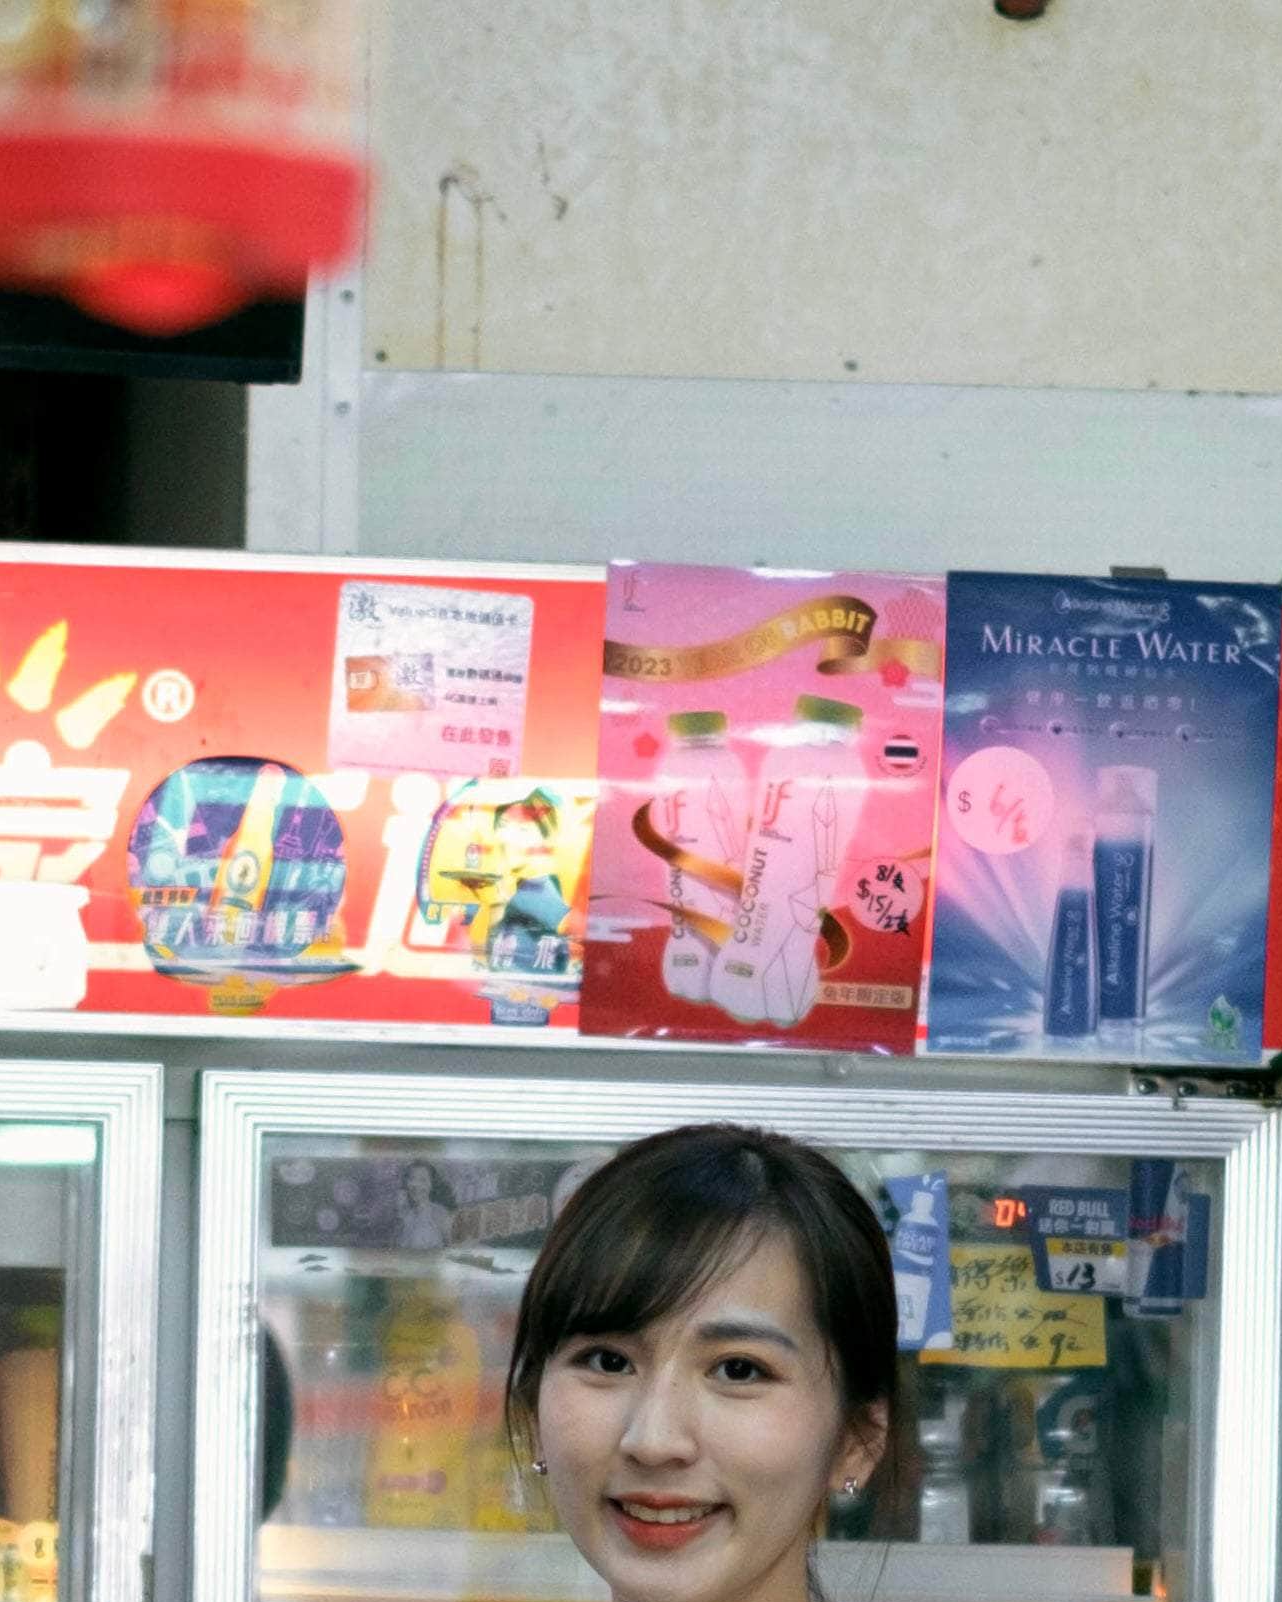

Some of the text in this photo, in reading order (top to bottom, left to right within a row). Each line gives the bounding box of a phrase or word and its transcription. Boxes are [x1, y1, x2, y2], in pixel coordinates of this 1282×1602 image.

[1136, 631, 1241, 664] WATER
[616, 653, 673, 676] 2023
[957, 790, 972, 813] $
[733, 847, 768, 944] COCONUT
